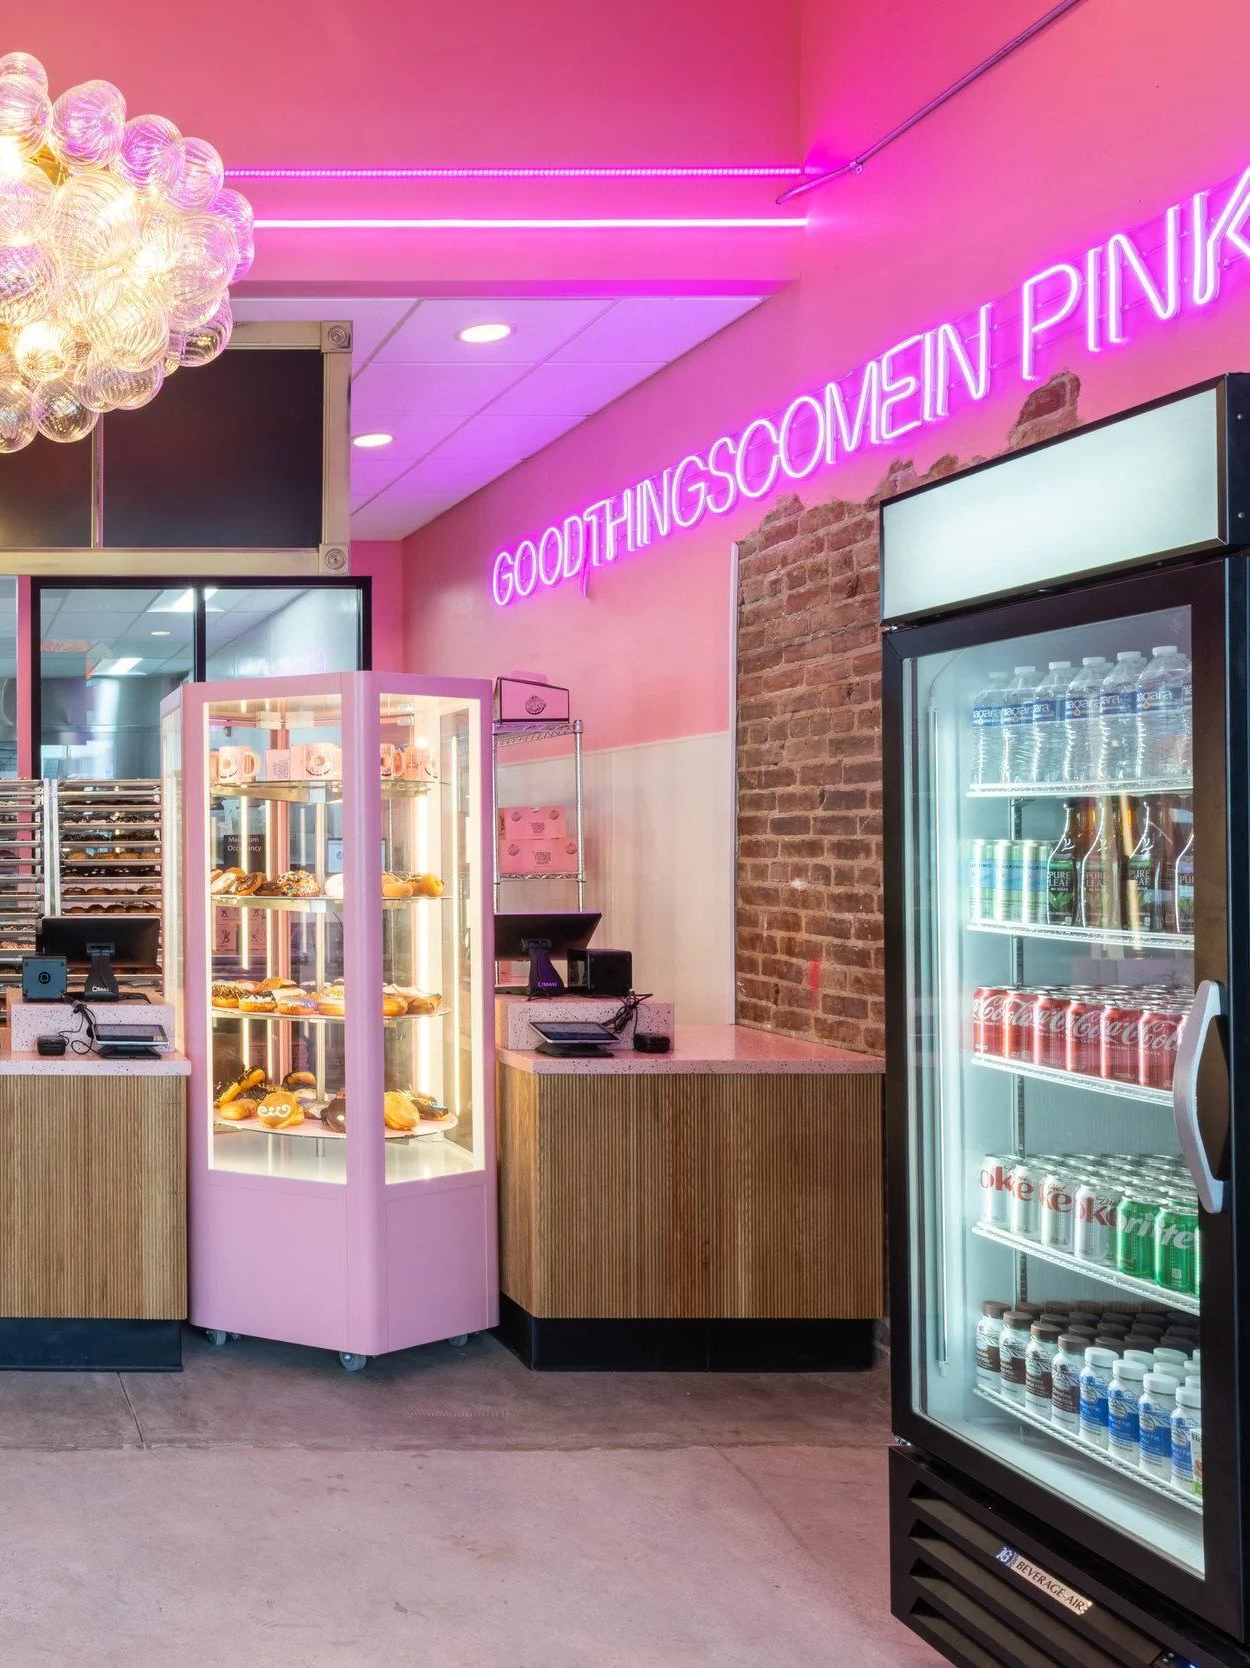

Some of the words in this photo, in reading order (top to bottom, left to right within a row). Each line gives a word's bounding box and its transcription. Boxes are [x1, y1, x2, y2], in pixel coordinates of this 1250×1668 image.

[492, 515, 585, 606] GOOD
[584, 437, 736, 567] THINGS
[736, 335, 922, 499] COME
[922, 302, 992, 422] IN
[1022, 165, 1250, 381] PINK
[1050, 871, 1071, 879] PURE
[1128, 870, 1150, 878] PURE
[1016, 1561, 1085, 1611] BEVERAGE-AIR
